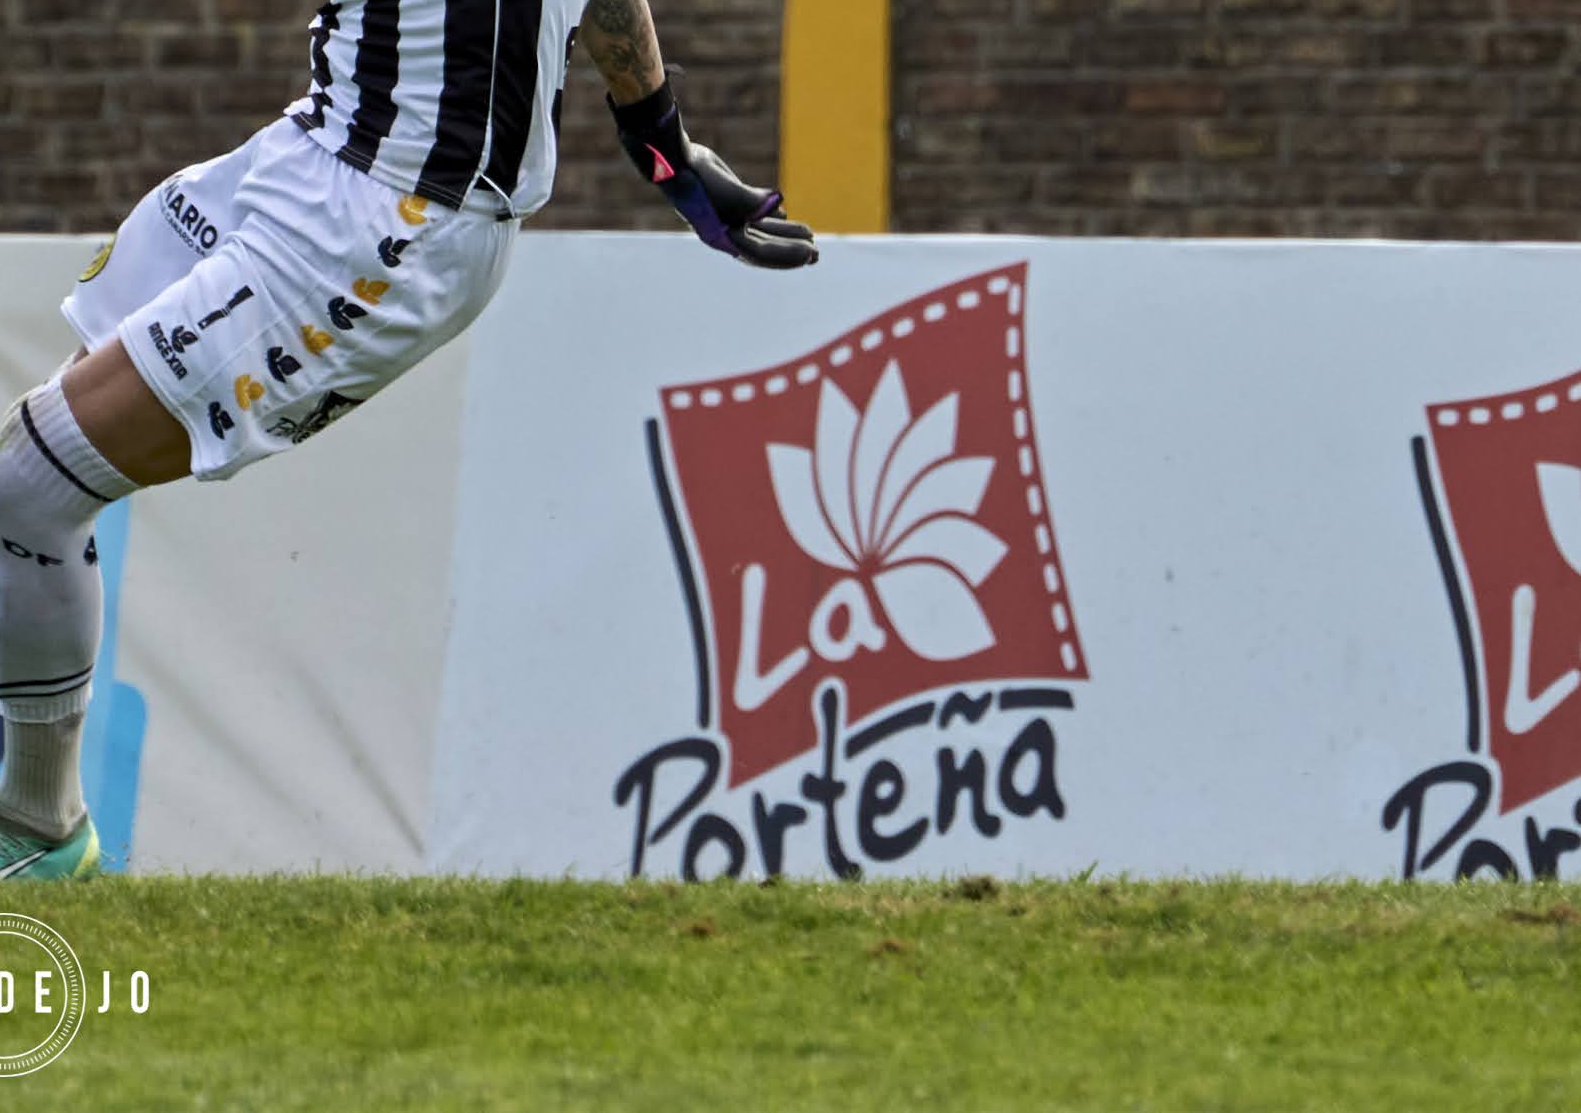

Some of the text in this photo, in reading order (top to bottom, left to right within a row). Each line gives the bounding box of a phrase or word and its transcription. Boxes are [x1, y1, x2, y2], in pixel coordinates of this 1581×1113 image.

[164, 173, 218, 249] NARIO
[734, 563, 886, 712] La
[1504, 584, 1581, 734] L
[614, 686, 1065, 883] Porteña
